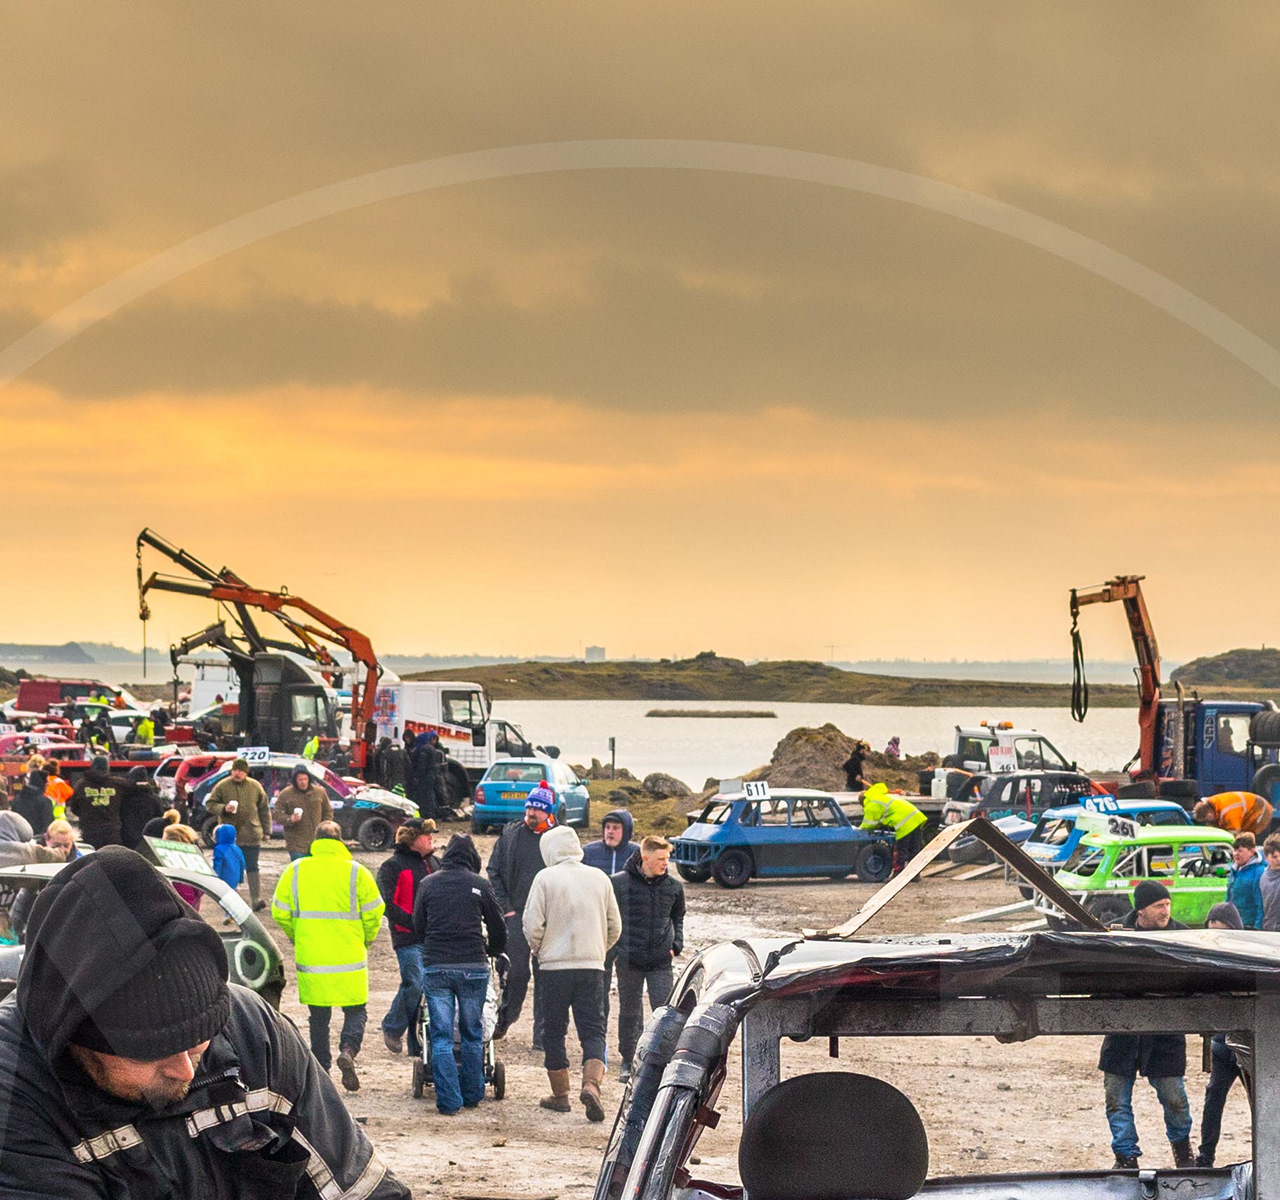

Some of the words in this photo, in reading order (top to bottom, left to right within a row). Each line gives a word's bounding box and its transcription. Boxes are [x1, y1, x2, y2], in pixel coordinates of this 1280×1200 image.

[241, 751, 266, 760] 220
[999, 763, 1016, 771] 461
[746, 783, 766, 796] 611
[1085, 797, 1118, 813] 476
[1108, 817, 1135, 838] 261
